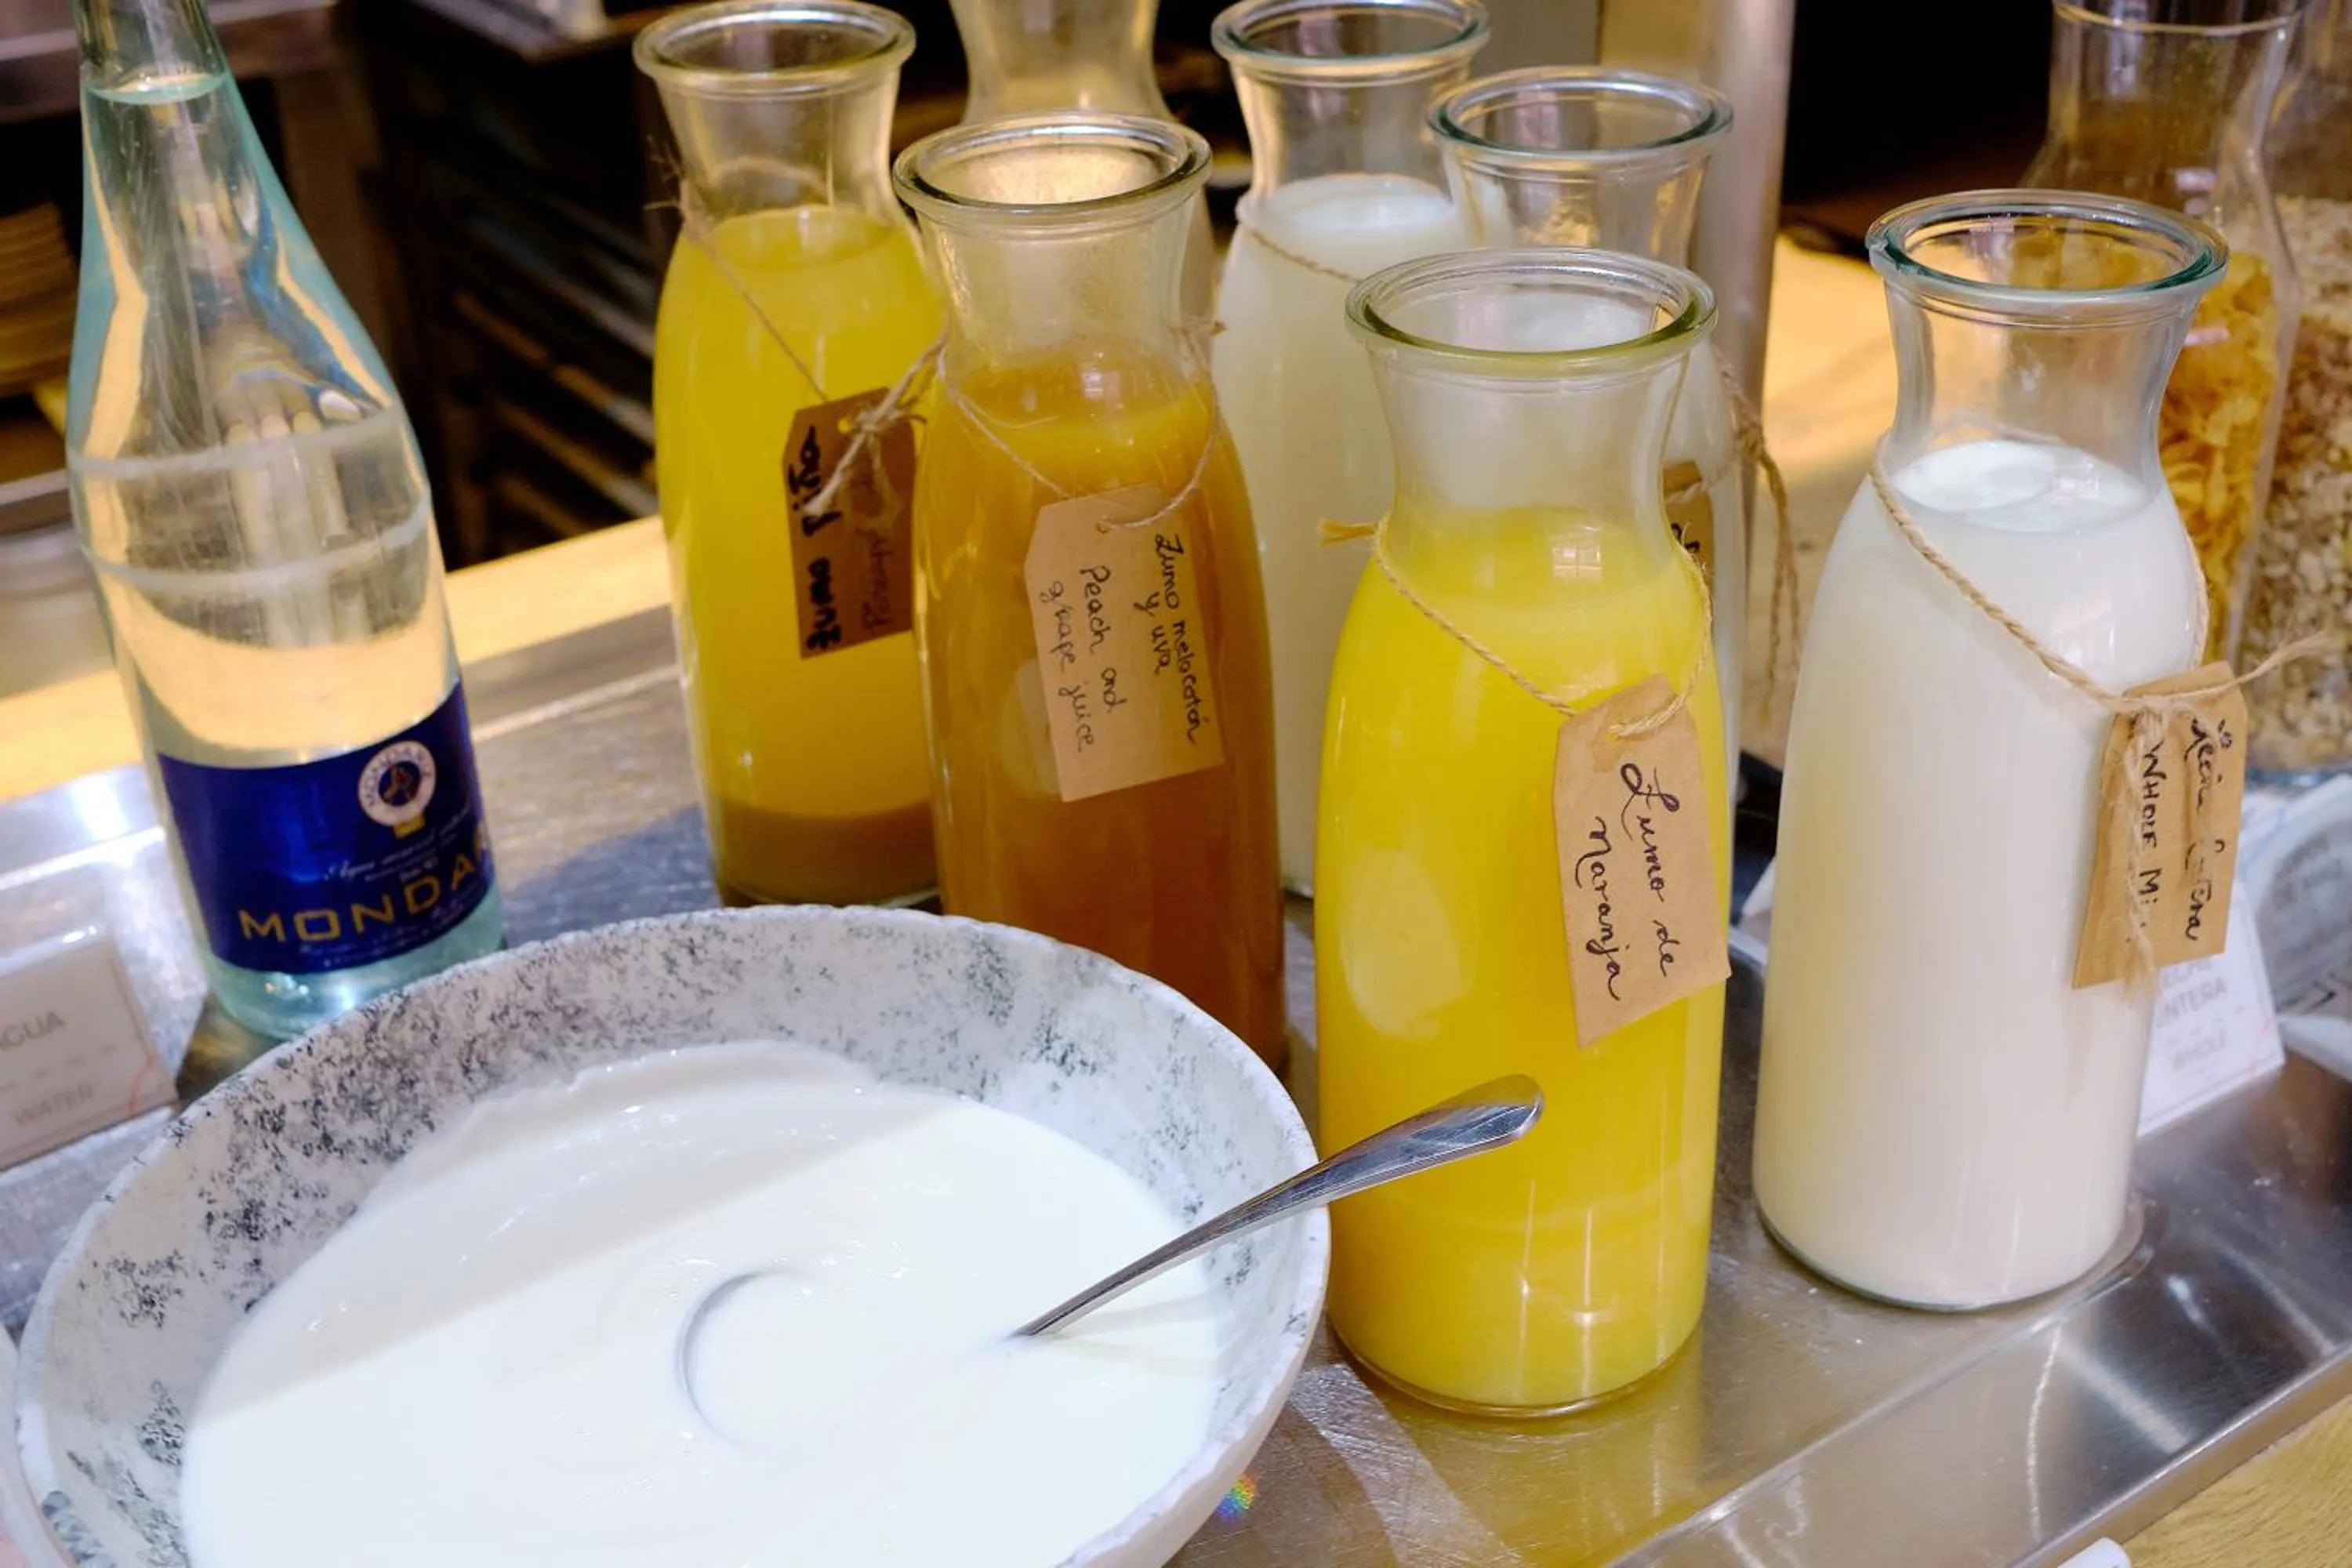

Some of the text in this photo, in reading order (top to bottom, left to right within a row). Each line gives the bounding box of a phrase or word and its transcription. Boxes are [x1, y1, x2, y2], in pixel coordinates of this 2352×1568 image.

[1134, 591, 1172, 676] y uva
[1155, 533, 1185, 610] Zumo
[1039, 580, 1095, 753] grape juice
[1080, 564, 1127, 713] Peach and
[238, 829, 484, 943] MONDA
[1621, 763, 1681, 978] Zumo de
